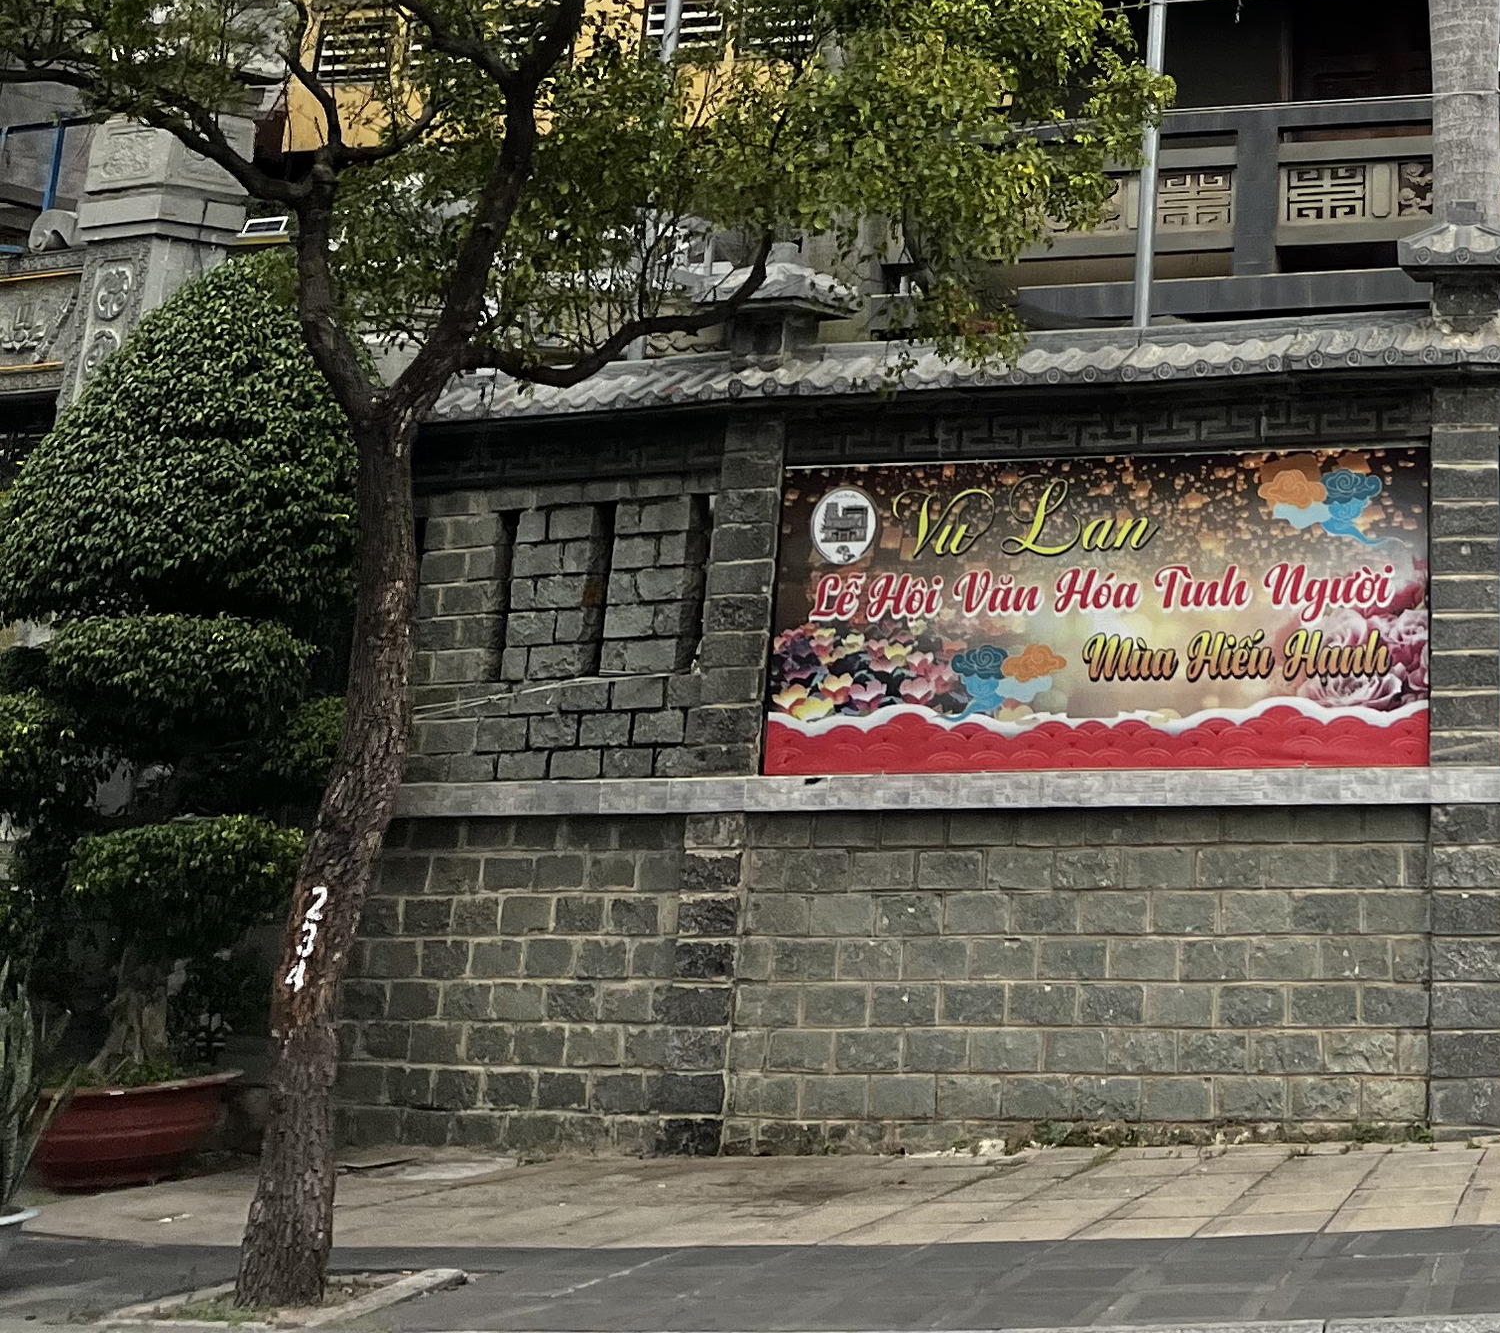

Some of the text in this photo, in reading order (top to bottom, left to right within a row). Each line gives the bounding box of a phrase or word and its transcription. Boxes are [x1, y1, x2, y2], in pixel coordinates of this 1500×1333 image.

[893, 473, 1161, 559] Vu Lan
[812, 563, 1393, 624] Lễ Hội Văn Hóa Tình Người
[1083, 629, 1392, 685] Mùa Hiếu Hạnh
